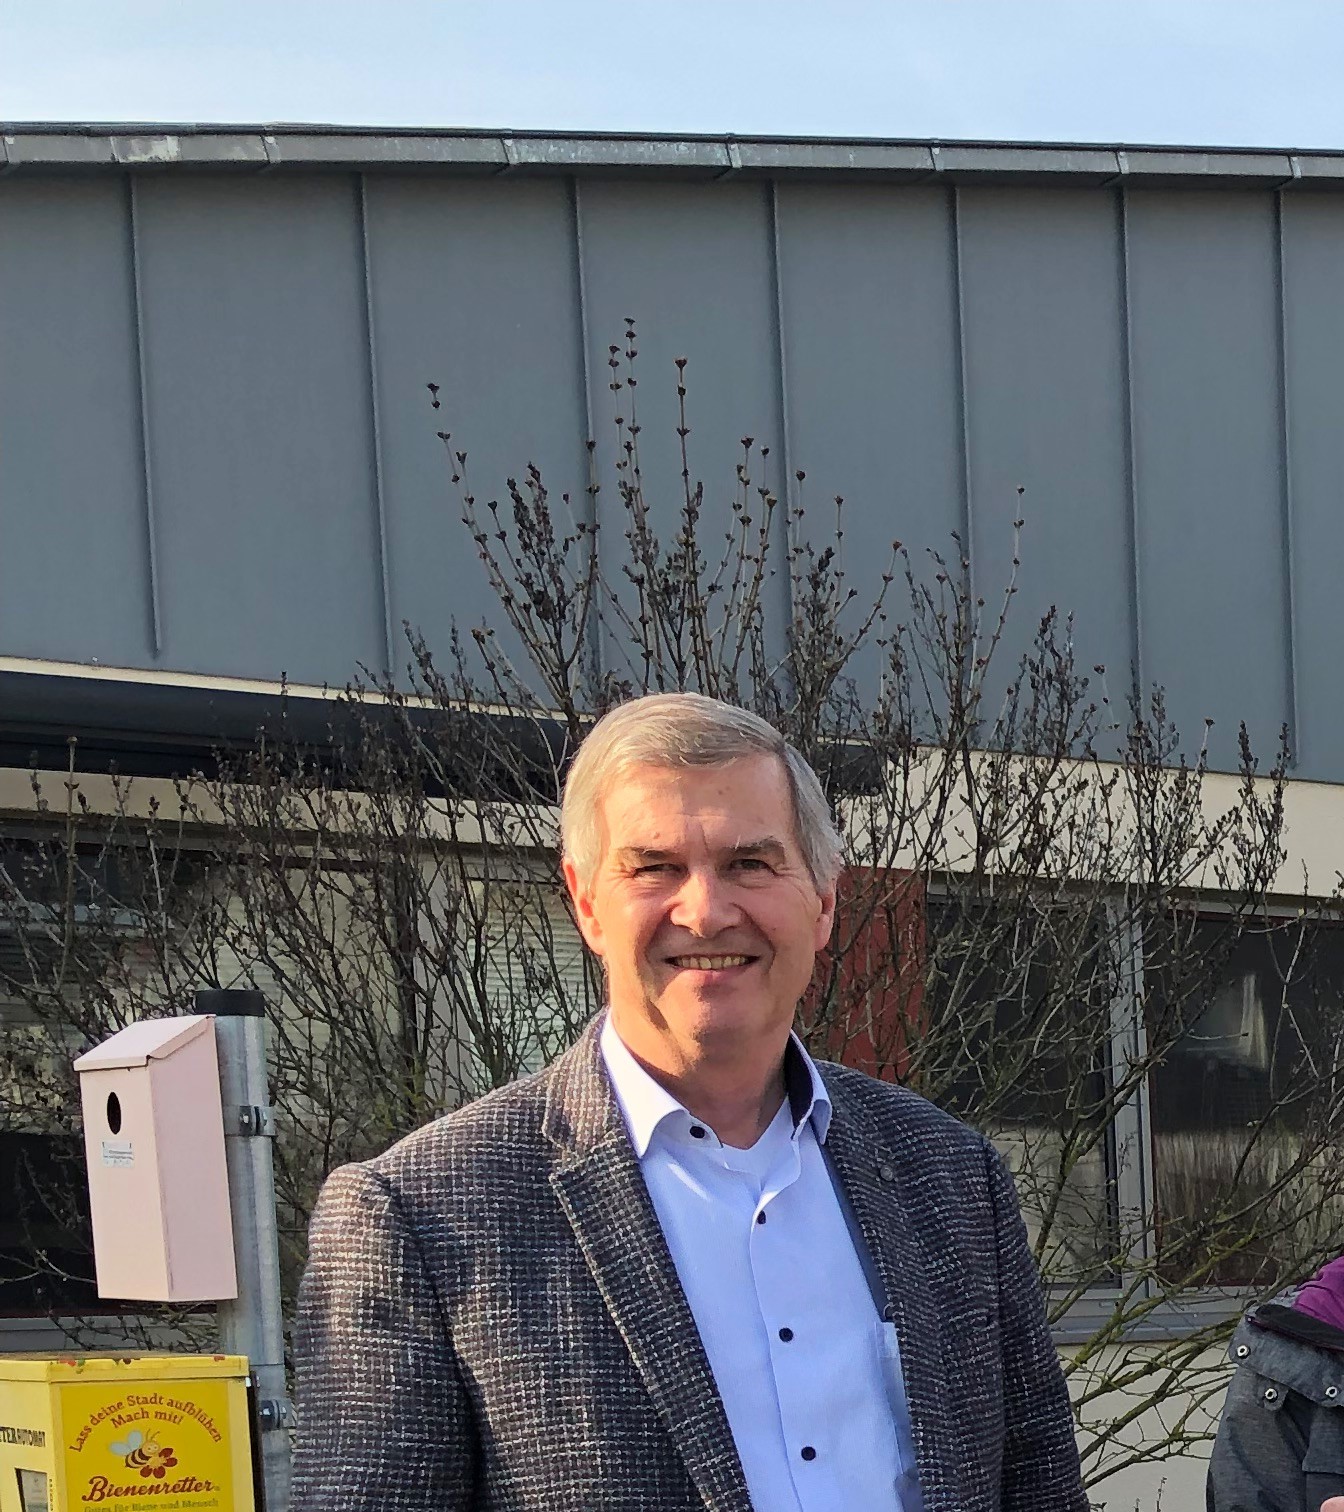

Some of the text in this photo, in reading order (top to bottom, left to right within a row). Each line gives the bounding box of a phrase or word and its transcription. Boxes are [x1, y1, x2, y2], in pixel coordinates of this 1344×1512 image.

[69, 1425, 92, 1453] Lass
[90, 1401, 124, 1426] deine
[126, 1393, 164, 1407] Stadt
[110, 1408, 150, 1429] Mach
[81, 1475, 214, 1502] Bienenretter
